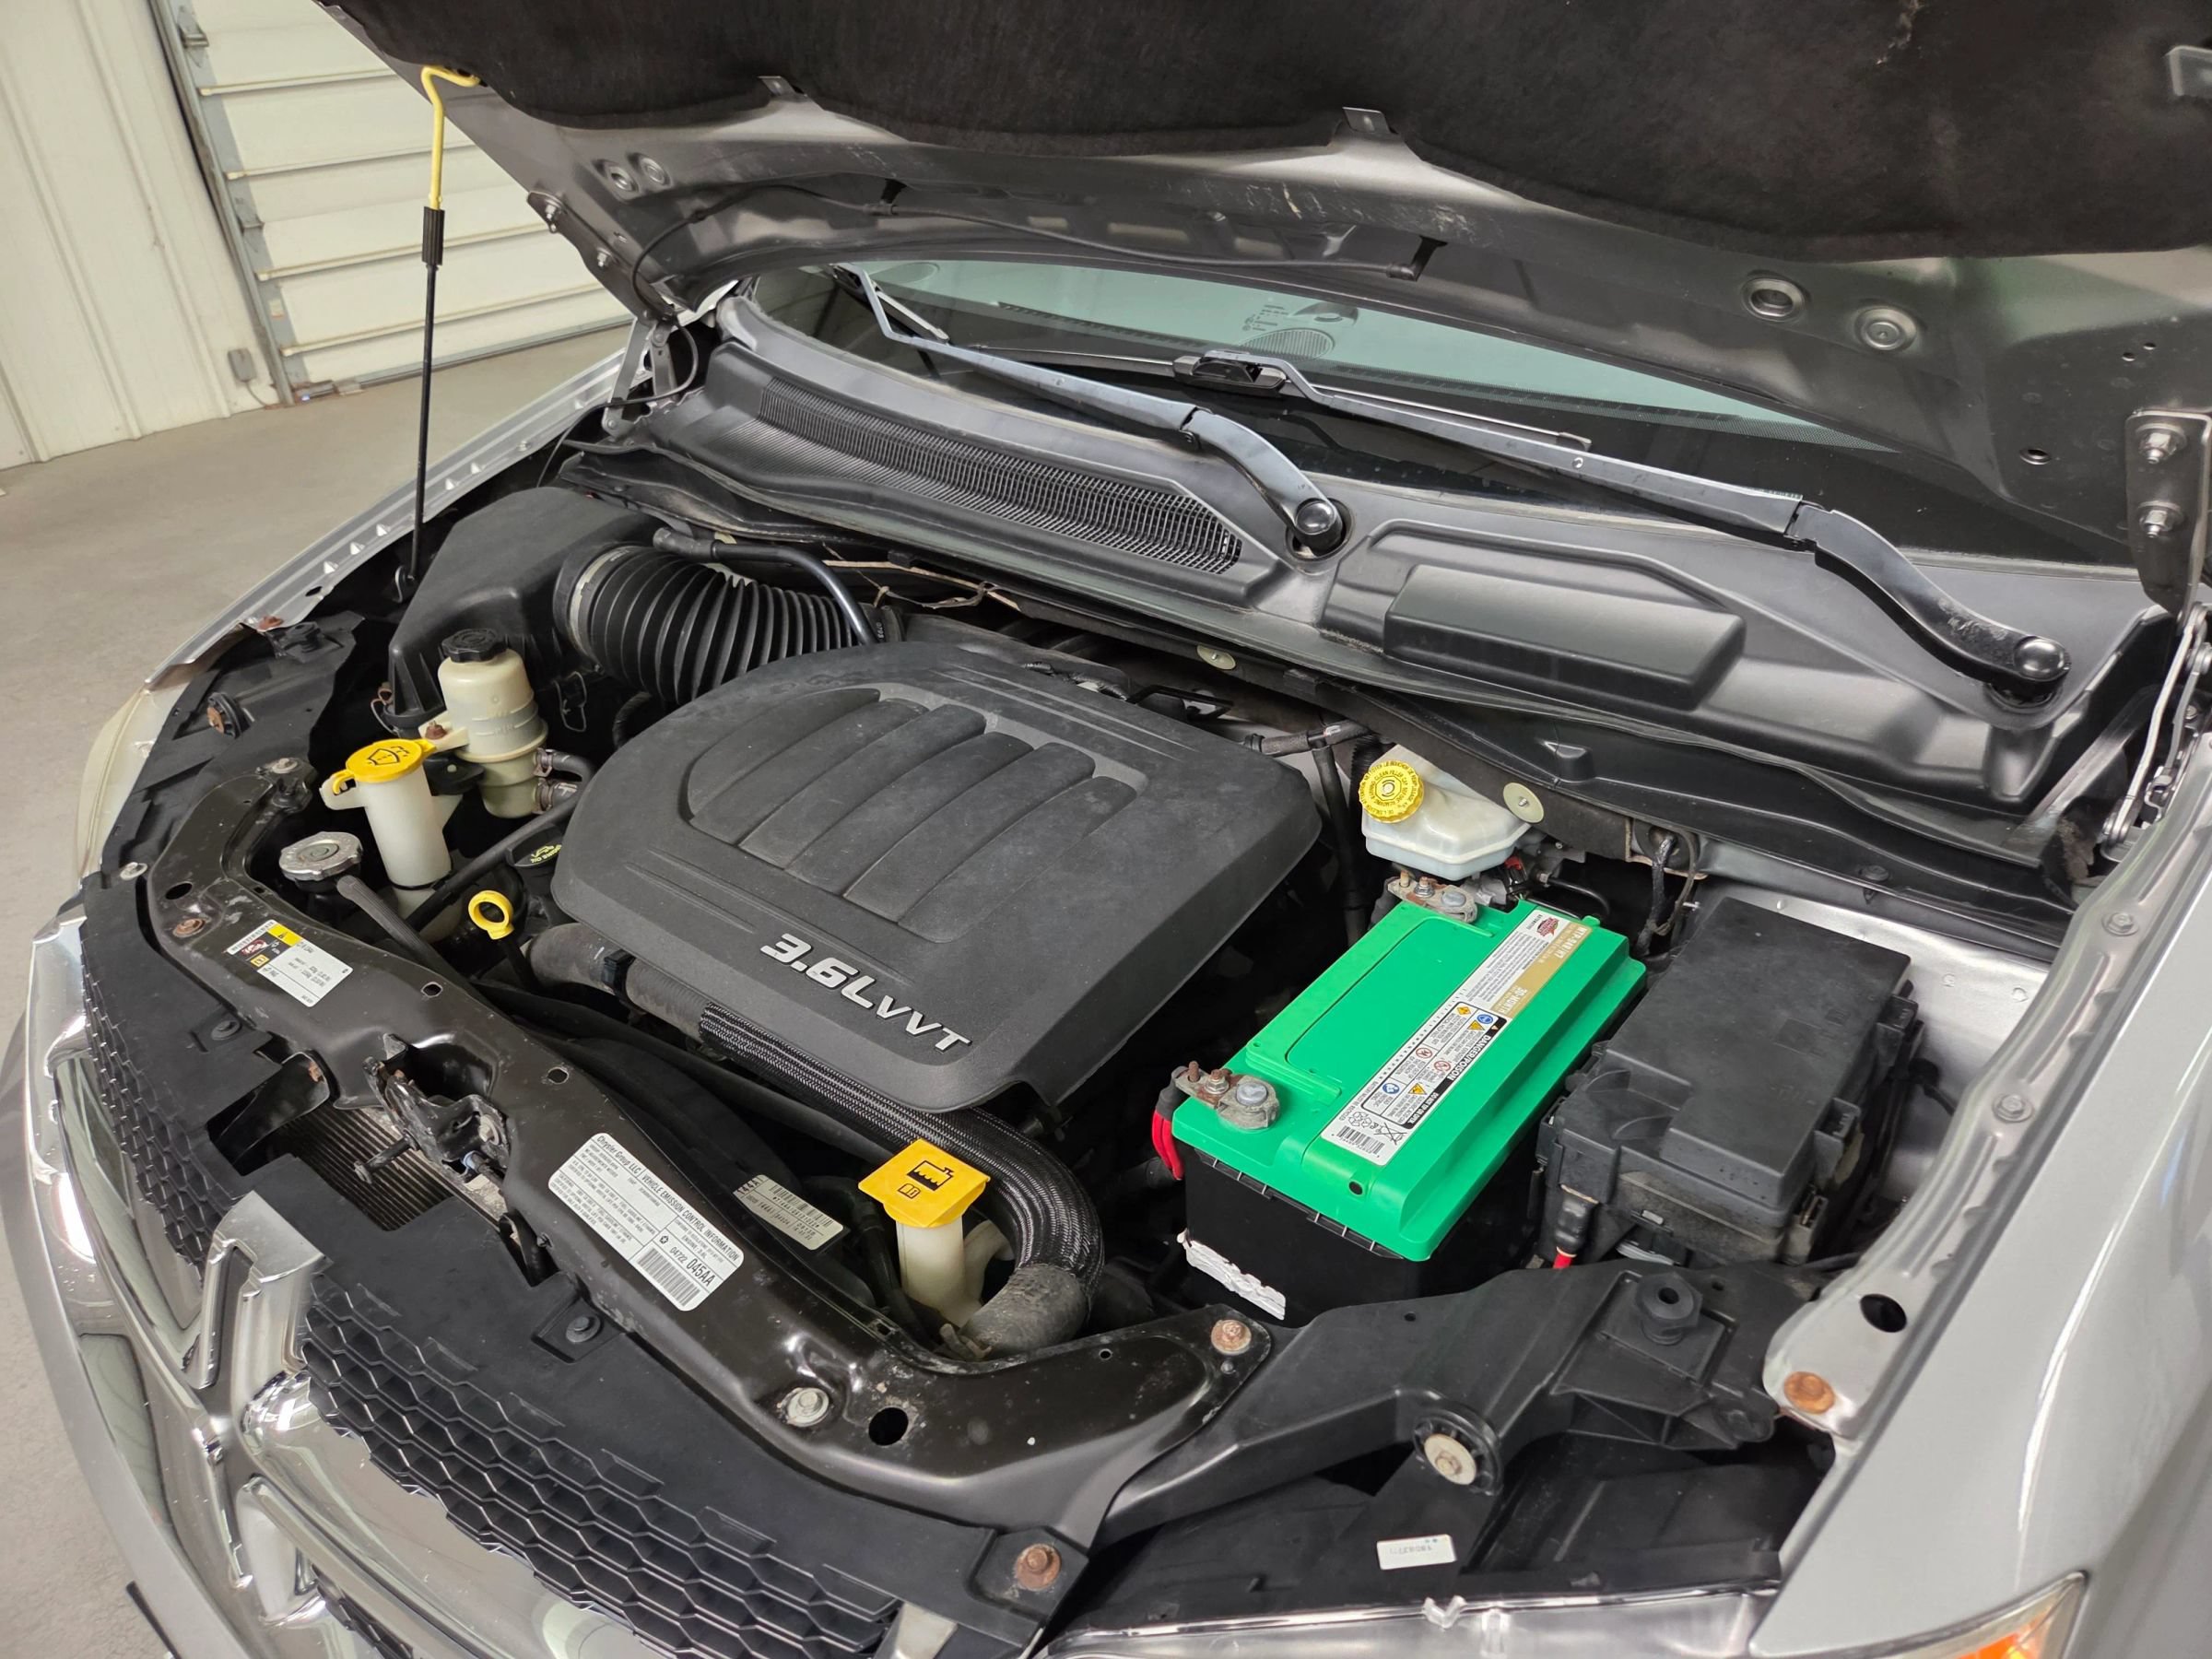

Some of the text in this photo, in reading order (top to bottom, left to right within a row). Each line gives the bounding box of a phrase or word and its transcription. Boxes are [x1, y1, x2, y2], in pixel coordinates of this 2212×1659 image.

[1374, 771, 1388, 781] CLEAN
[1447, 1035, 1491, 1080] DANGER/POISON
[597, 1135, 618, 1154] Chrysler
[615, 1152, 630, 1166] Group
[629, 1163, 641, 1173] LLC
[642, 1175, 663, 1193] VEHICLE
[661, 1191, 684, 1212] EMISSION
[683, 1211, 706, 1231] CONTROL
[704, 1230, 739, 1261] INFORMATION
[670, 1248, 687, 1263] 04722
[687, 1259, 716, 1286] 045AA
